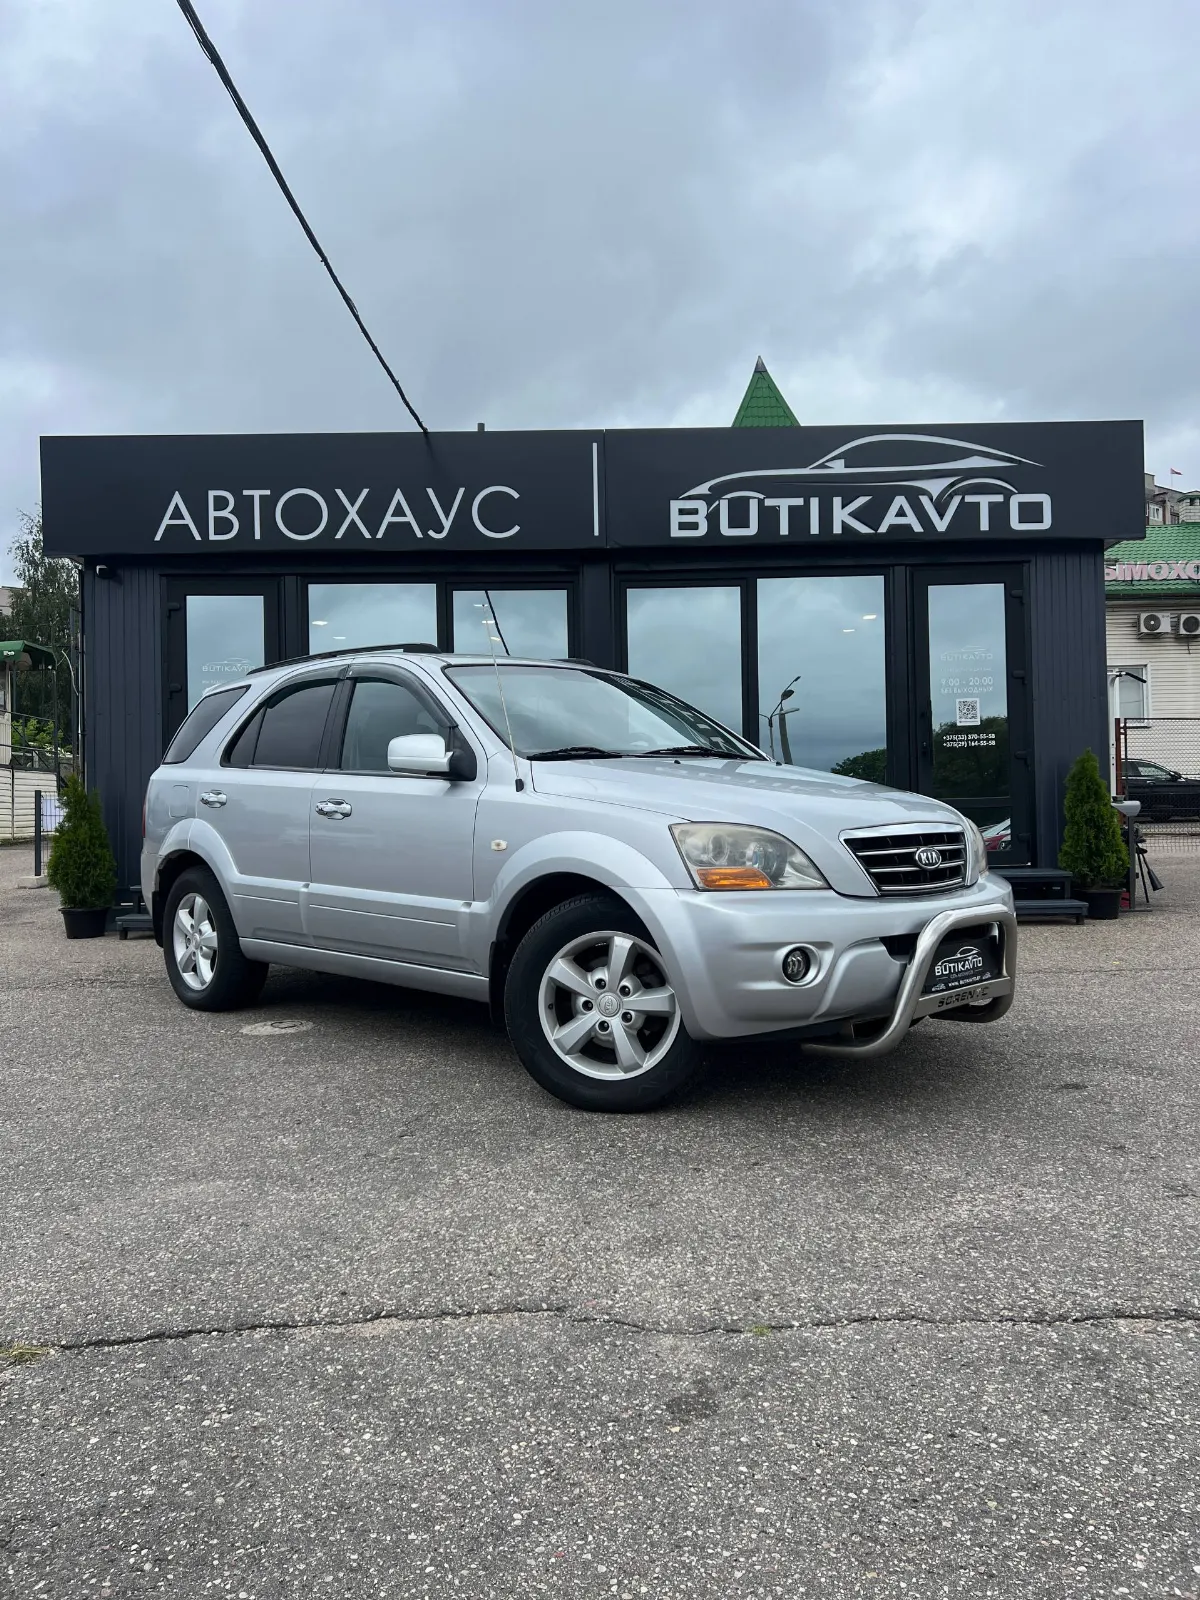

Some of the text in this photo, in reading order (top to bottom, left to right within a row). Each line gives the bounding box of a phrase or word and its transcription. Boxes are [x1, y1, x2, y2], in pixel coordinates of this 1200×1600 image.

[153, 485, 522, 542] АВТОХАУС
[669, 493, 1052, 538] BUTIKAVTO
[969, 676, 994, 685] 20:00
[919, 851, 940, 864] KIA
[934, 957, 983, 976] BUTIKAVTO
